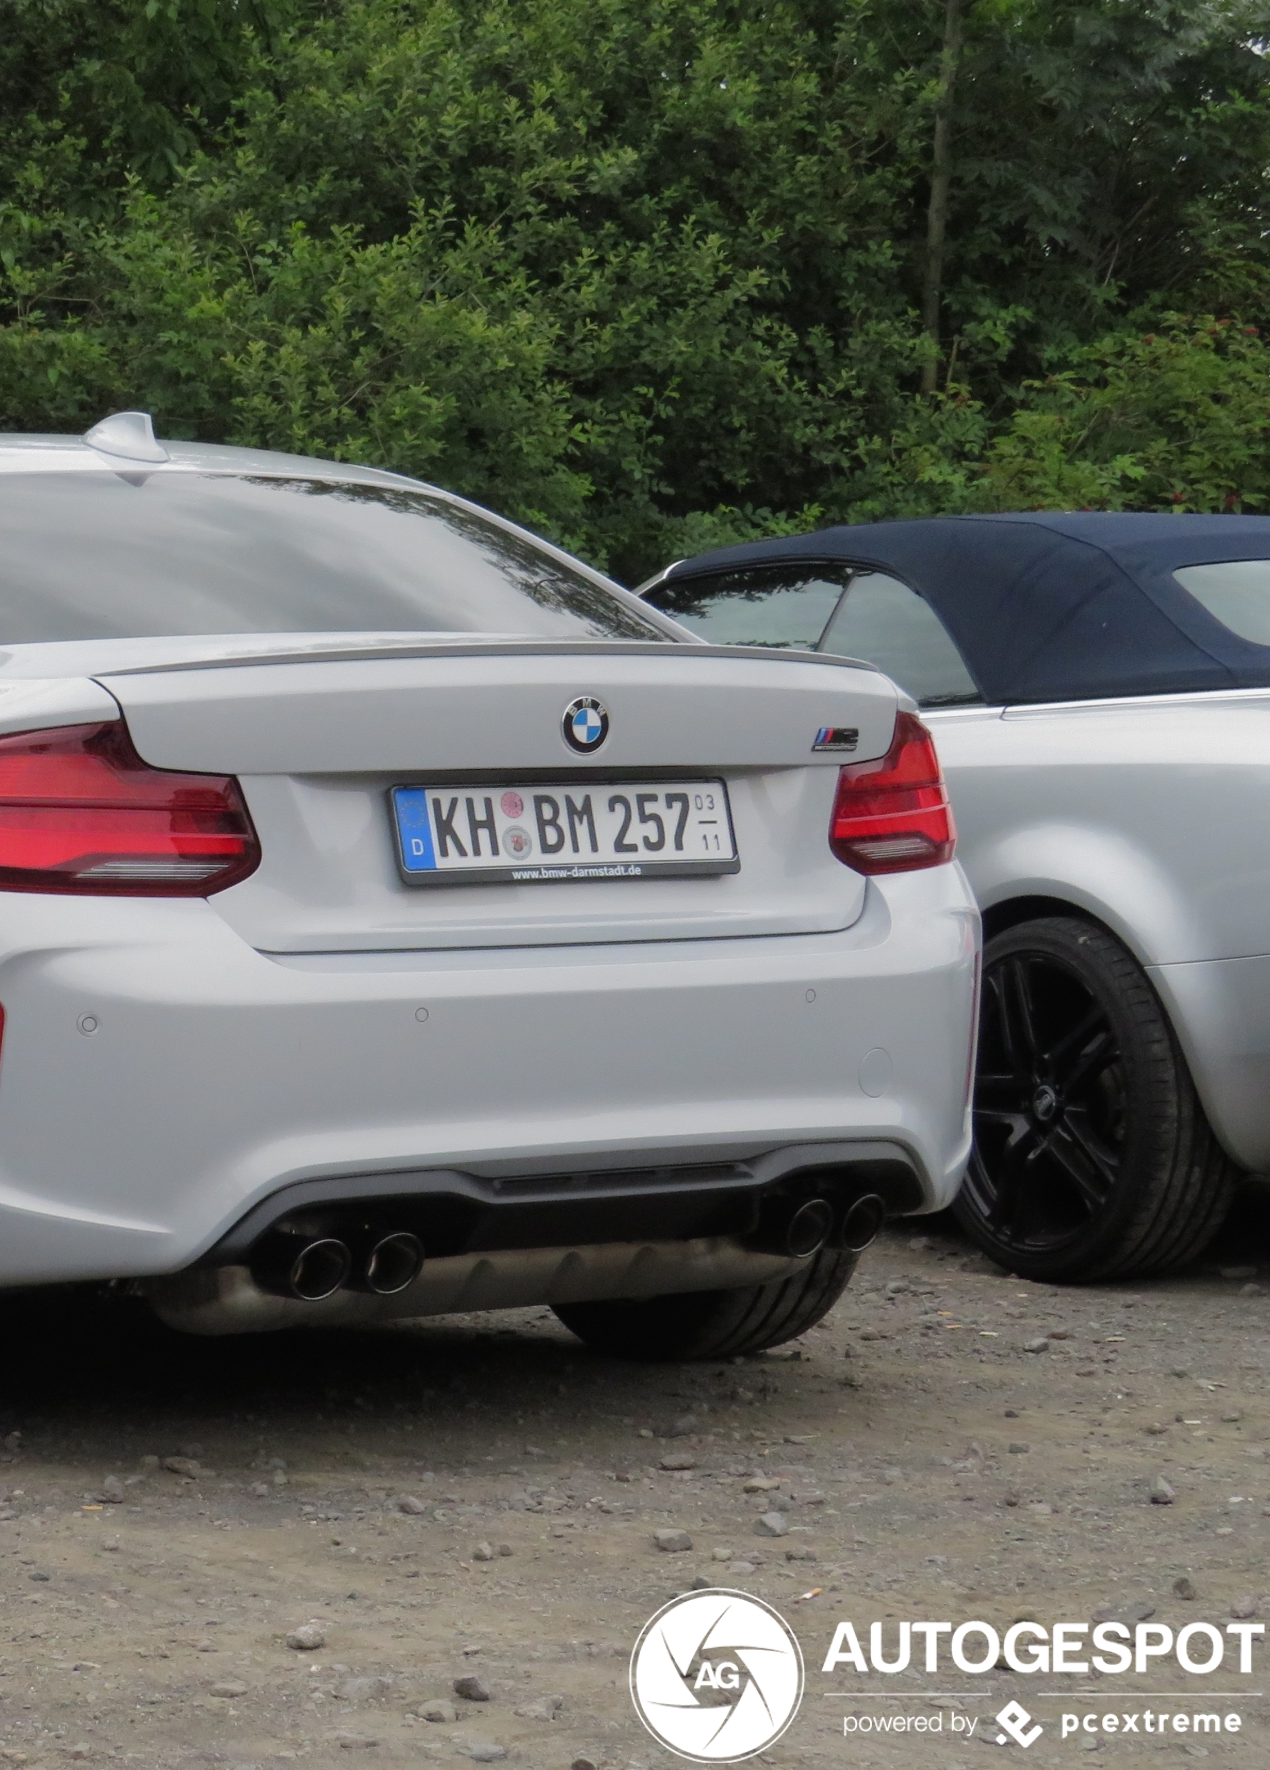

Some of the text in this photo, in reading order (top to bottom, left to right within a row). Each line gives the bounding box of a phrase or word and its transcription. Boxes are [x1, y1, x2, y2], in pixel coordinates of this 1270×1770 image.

[568, 698, 606, 717] BMW
[694, 794, 716, 811] 03
[432, 793, 690, 857] KH BM 257
[411, 838, 424, 856] D
[702, 833, 721, 851] 11
[512, 864, 642, 881] www.bmw-darmstadt.de
